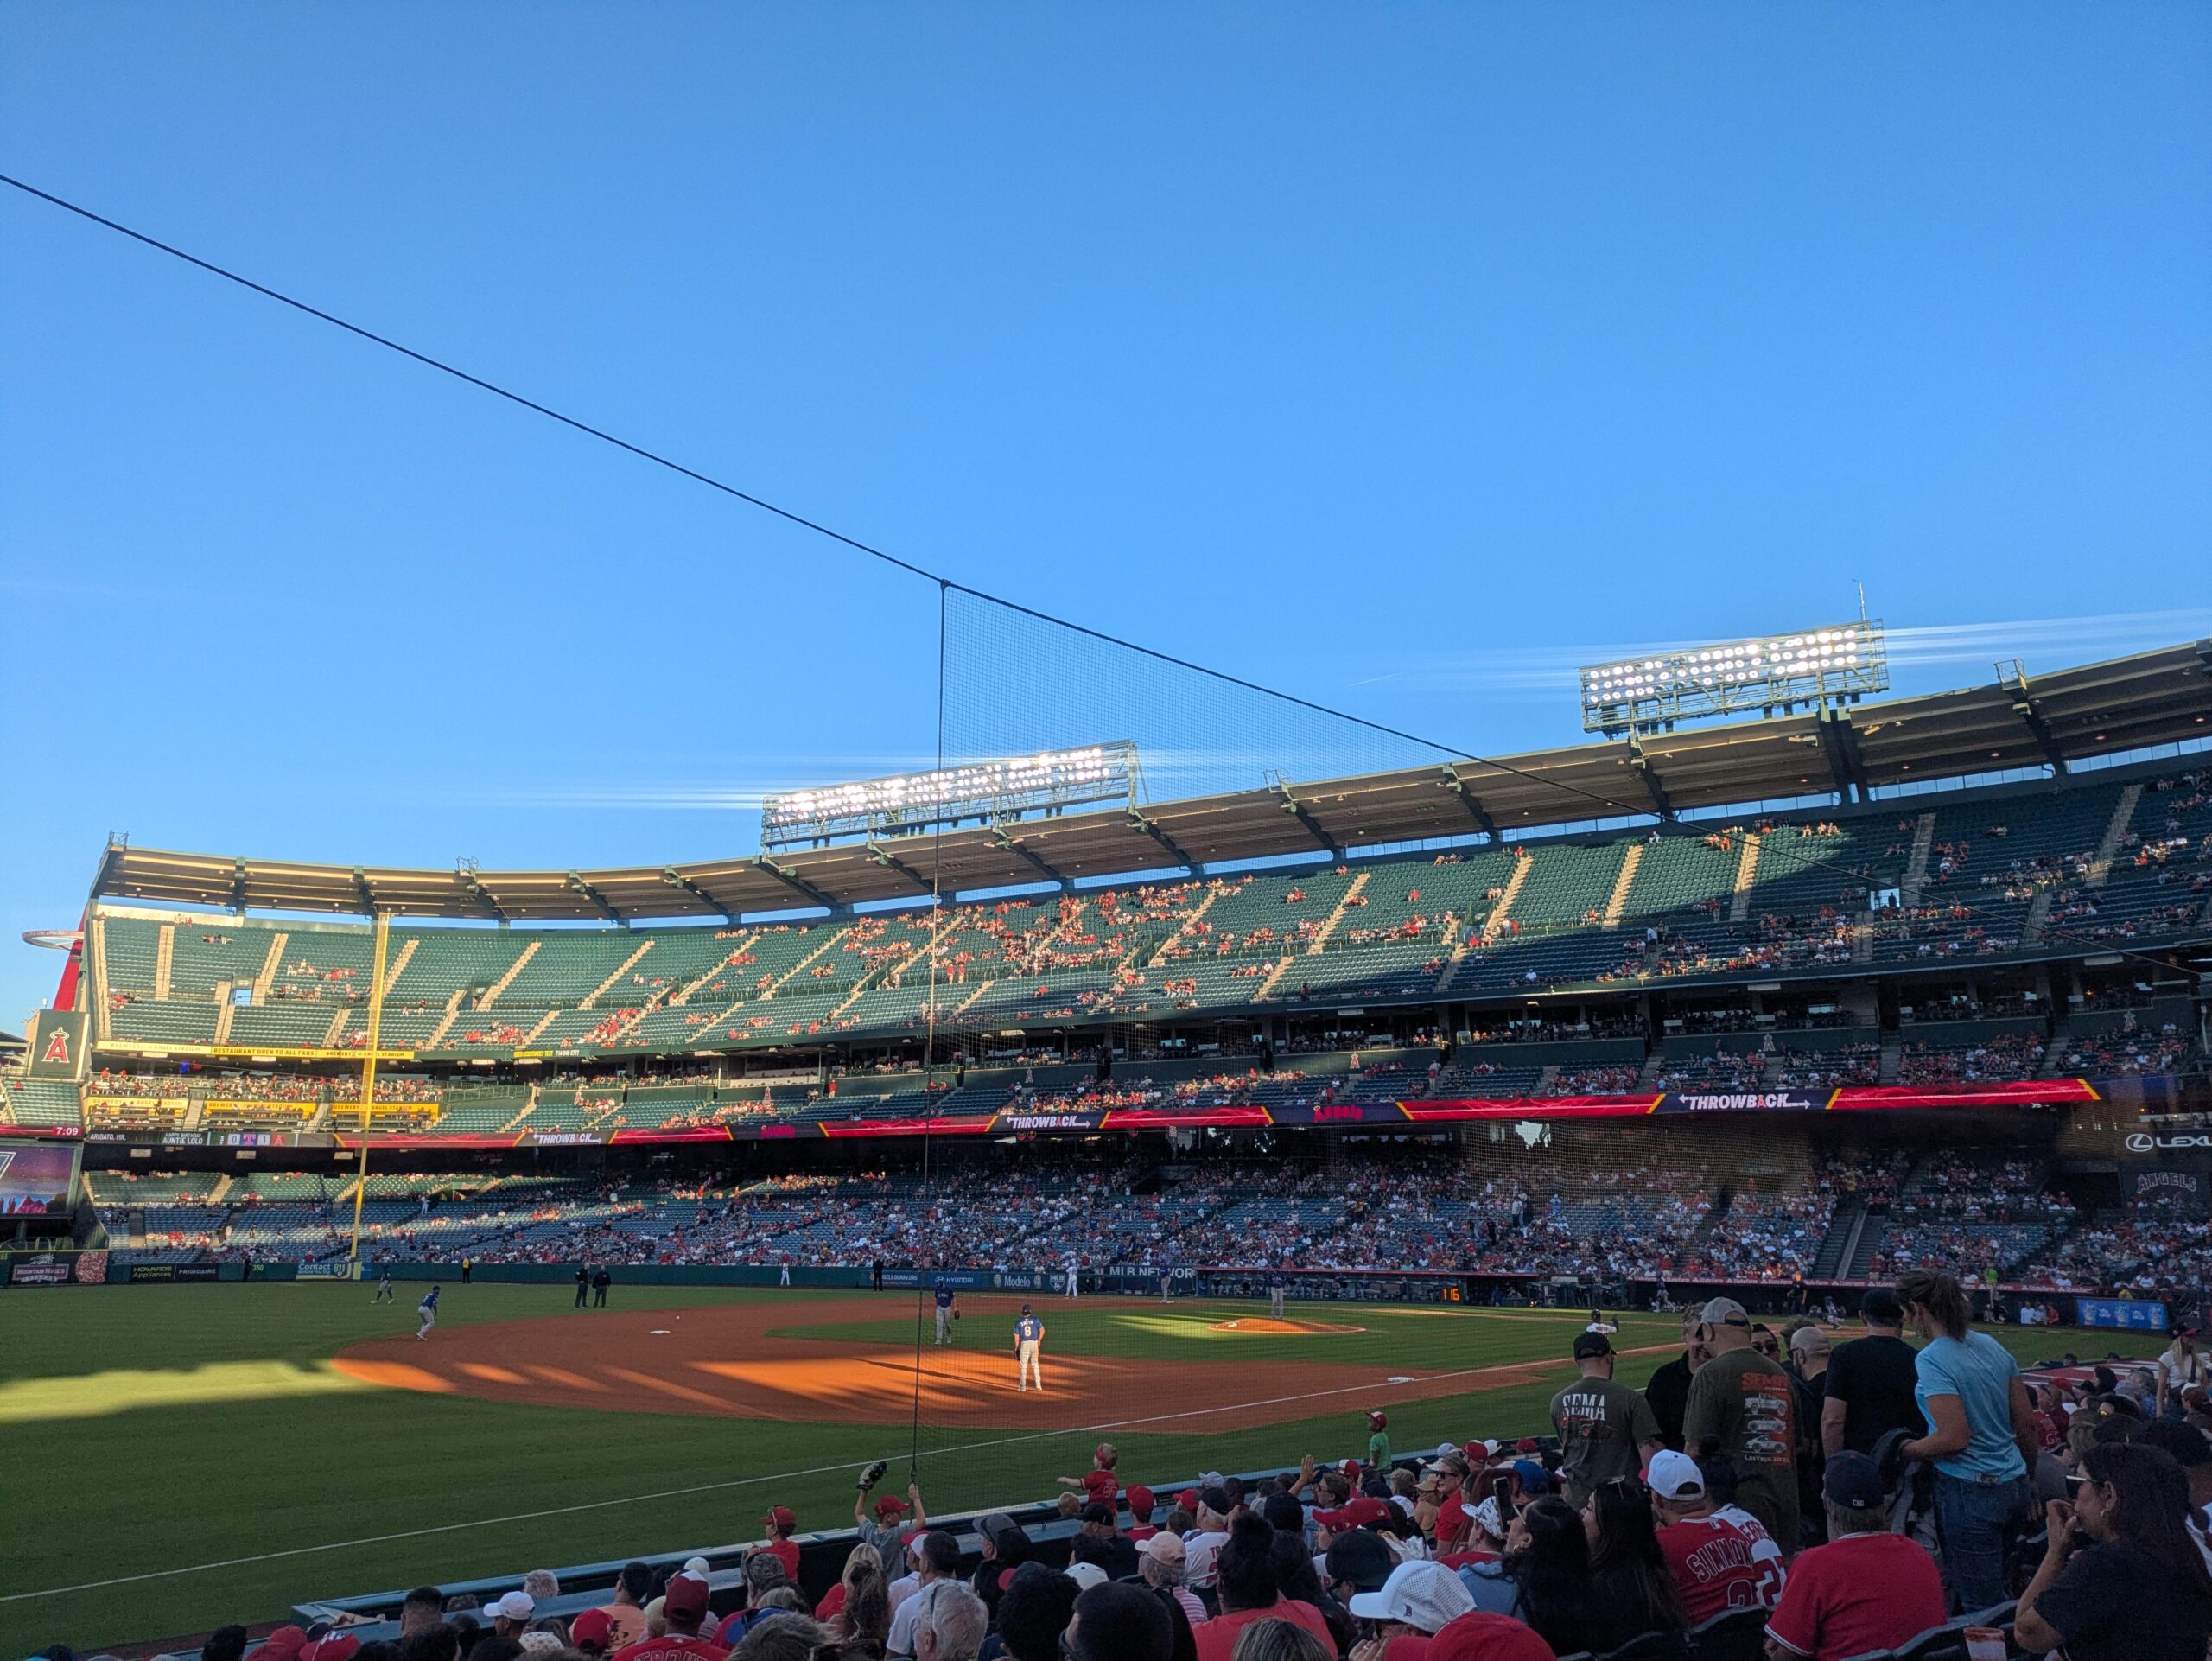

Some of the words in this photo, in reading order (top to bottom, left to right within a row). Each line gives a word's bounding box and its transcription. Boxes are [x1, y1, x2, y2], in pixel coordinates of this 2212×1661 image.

[41, 1026, 70, 1063] A
[1689, 1093, 1789, 1110] THROWBACK
[1013, 1115, 1077, 1129] THROWBACK
[538, 1133, 593, 1144] THROWBACK
[2137, 1172, 2196, 1194] ANGELS
[334, 1263, 346, 1273] 811
[1004, 1275, 1031, 1287] Modelo
[1024, 1326, 1032, 1337] 8
[1562, 1393, 1606, 1421] SEMA
